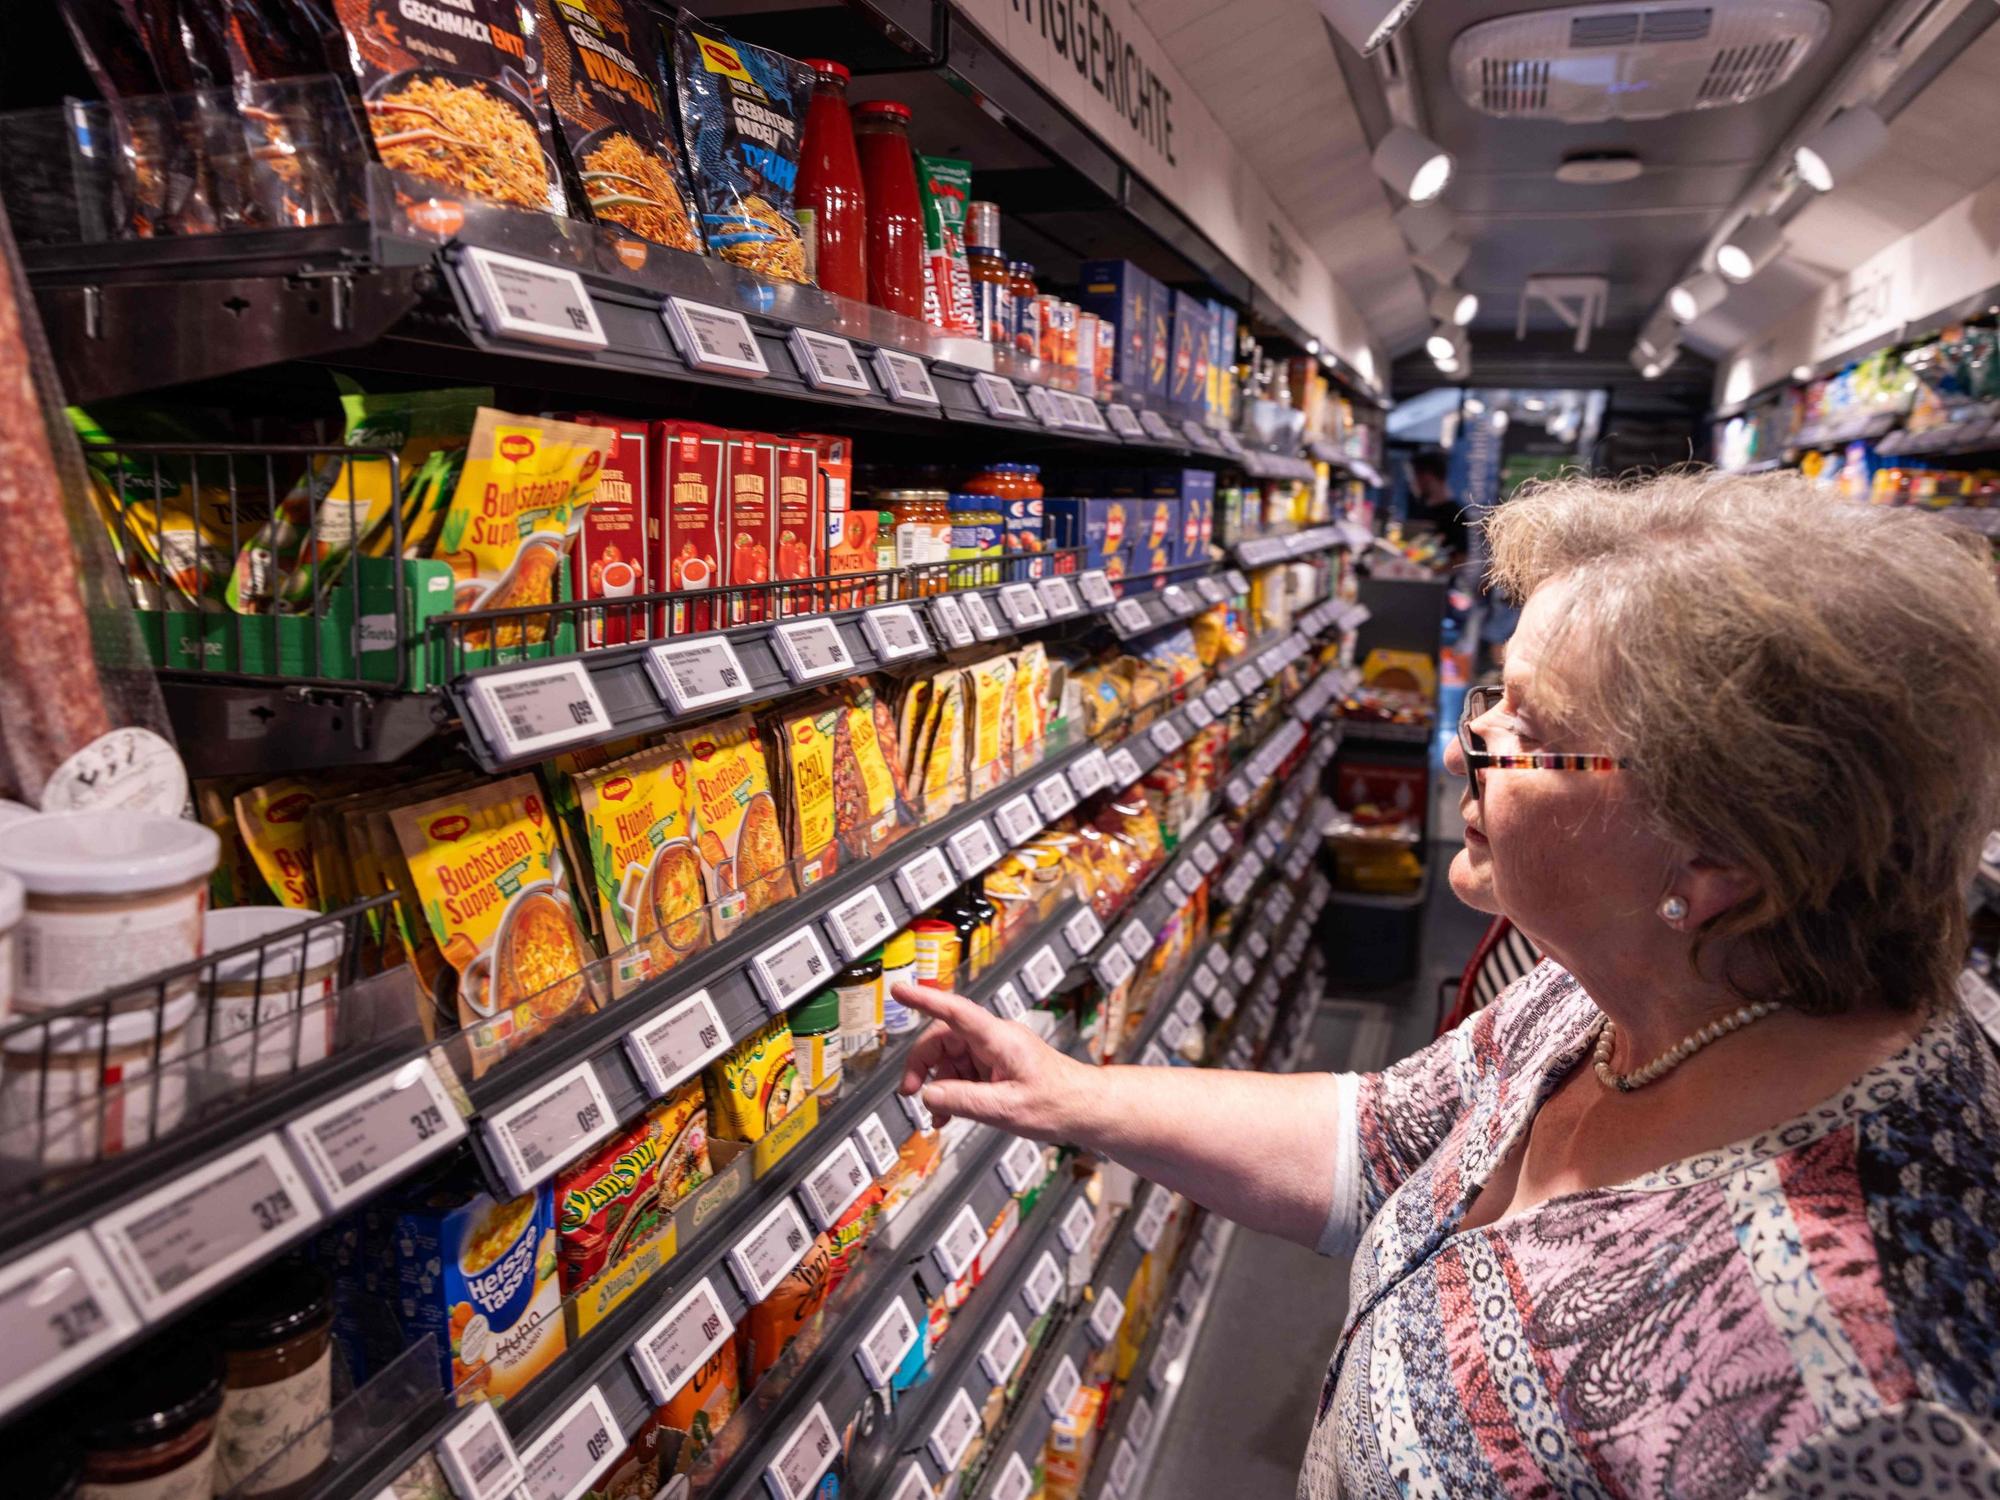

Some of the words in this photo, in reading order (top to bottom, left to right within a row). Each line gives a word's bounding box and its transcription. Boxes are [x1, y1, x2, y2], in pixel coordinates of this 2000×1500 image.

[399, 2, 493, 45] GESCHMACK
[1012, 0, 1176, 167] GGERICHTE
[436, 830, 532, 898] Buchstaben
[445, 881, 500, 925] Suppe
[468, 1225, 537, 1300] Heisse
[479, 1251, 532, 1313] Tasse
